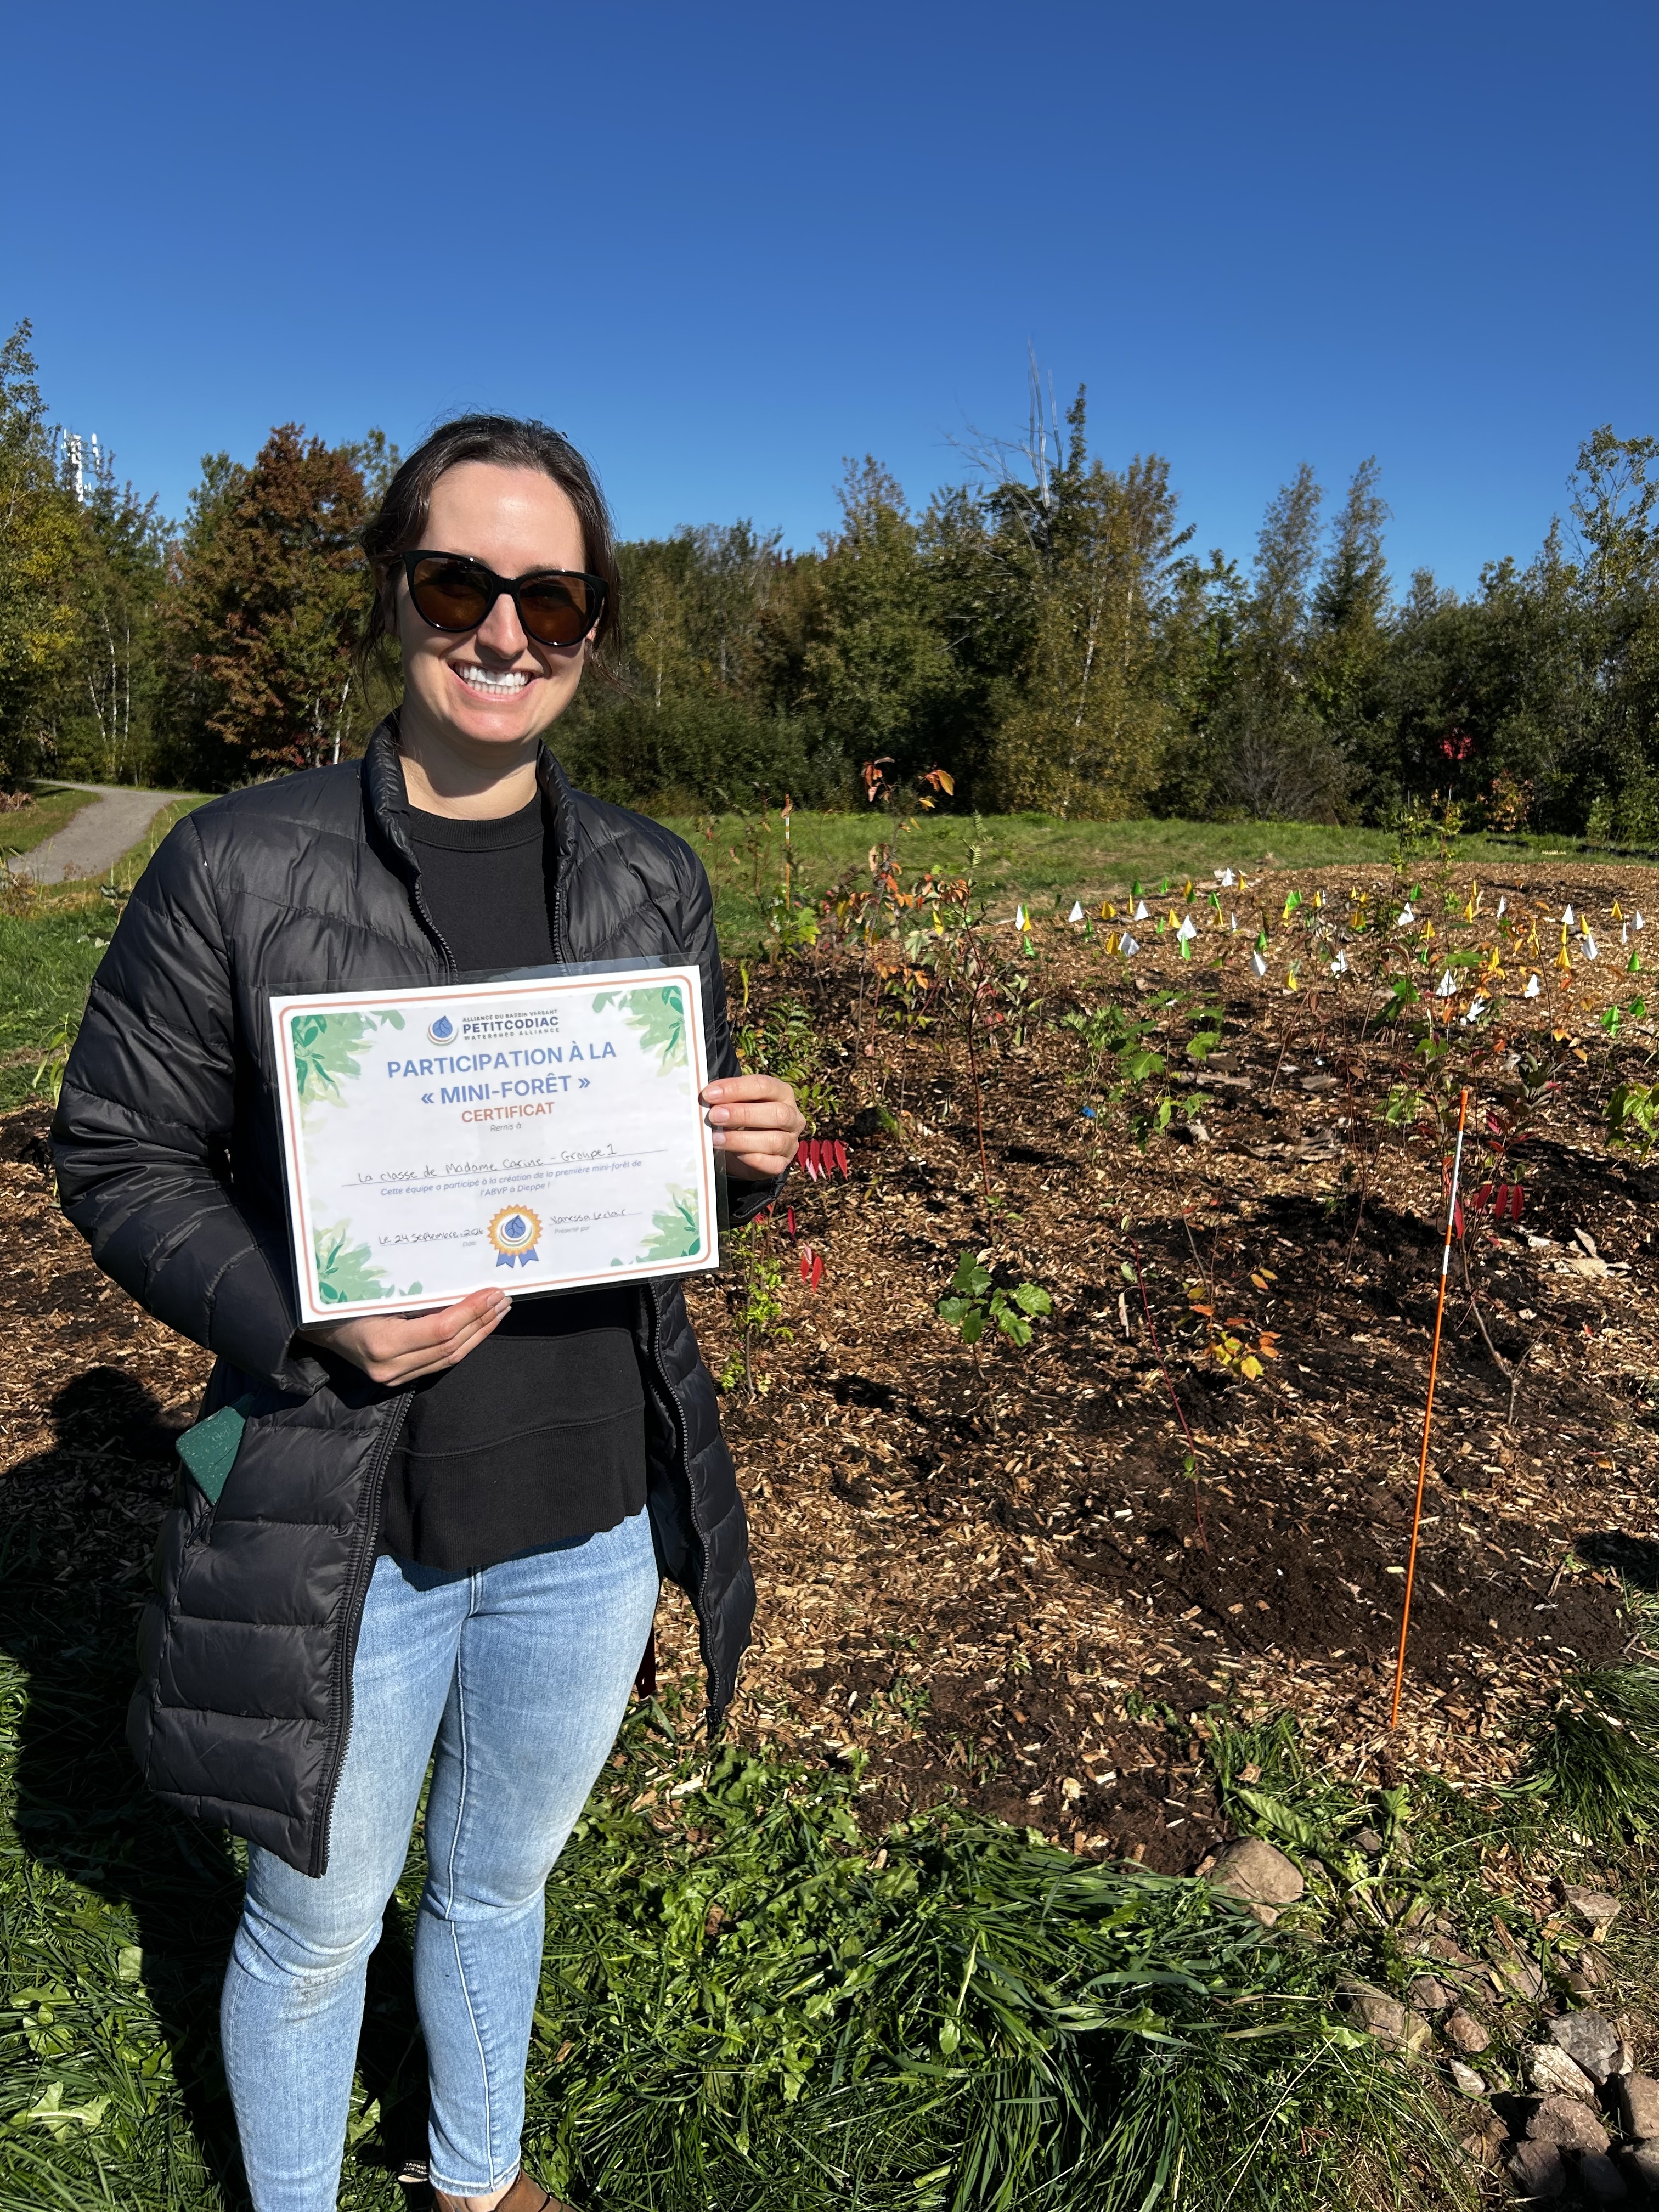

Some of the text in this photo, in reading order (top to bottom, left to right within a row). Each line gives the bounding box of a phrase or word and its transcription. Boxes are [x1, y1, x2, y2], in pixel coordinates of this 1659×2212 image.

[463, 1016, 559, 1034] PETITCODIAC
[464, 1032, 514, 1040] WATERSHED
[387, 1041, 617, 1078] PARTICIPATION À LA
[441, 1073, 572, 1104] MINI-FORÊT
[462, 1102, 555, 1123] CERTIFICAT
[381, 1171, 417, 1181] classe
[424, 1165, 438, 1177] de
[446, 1162, 497, 1173] Madame
[561, 1149, 605, 1161] Groupe
[381, 1187, 403, 1195] Cette
[406, 1185, 433, 1194] équipe
[444, 1180, 479, 1192] participé
[499, 1171, 532, 1183] création
[556, 1167, 590, 1178] première
[517, 1183, 545, 1193] Dieppe
[550, 1214, 590, 1223] Vanessa
[395, 1234, 409, 1243] 24
